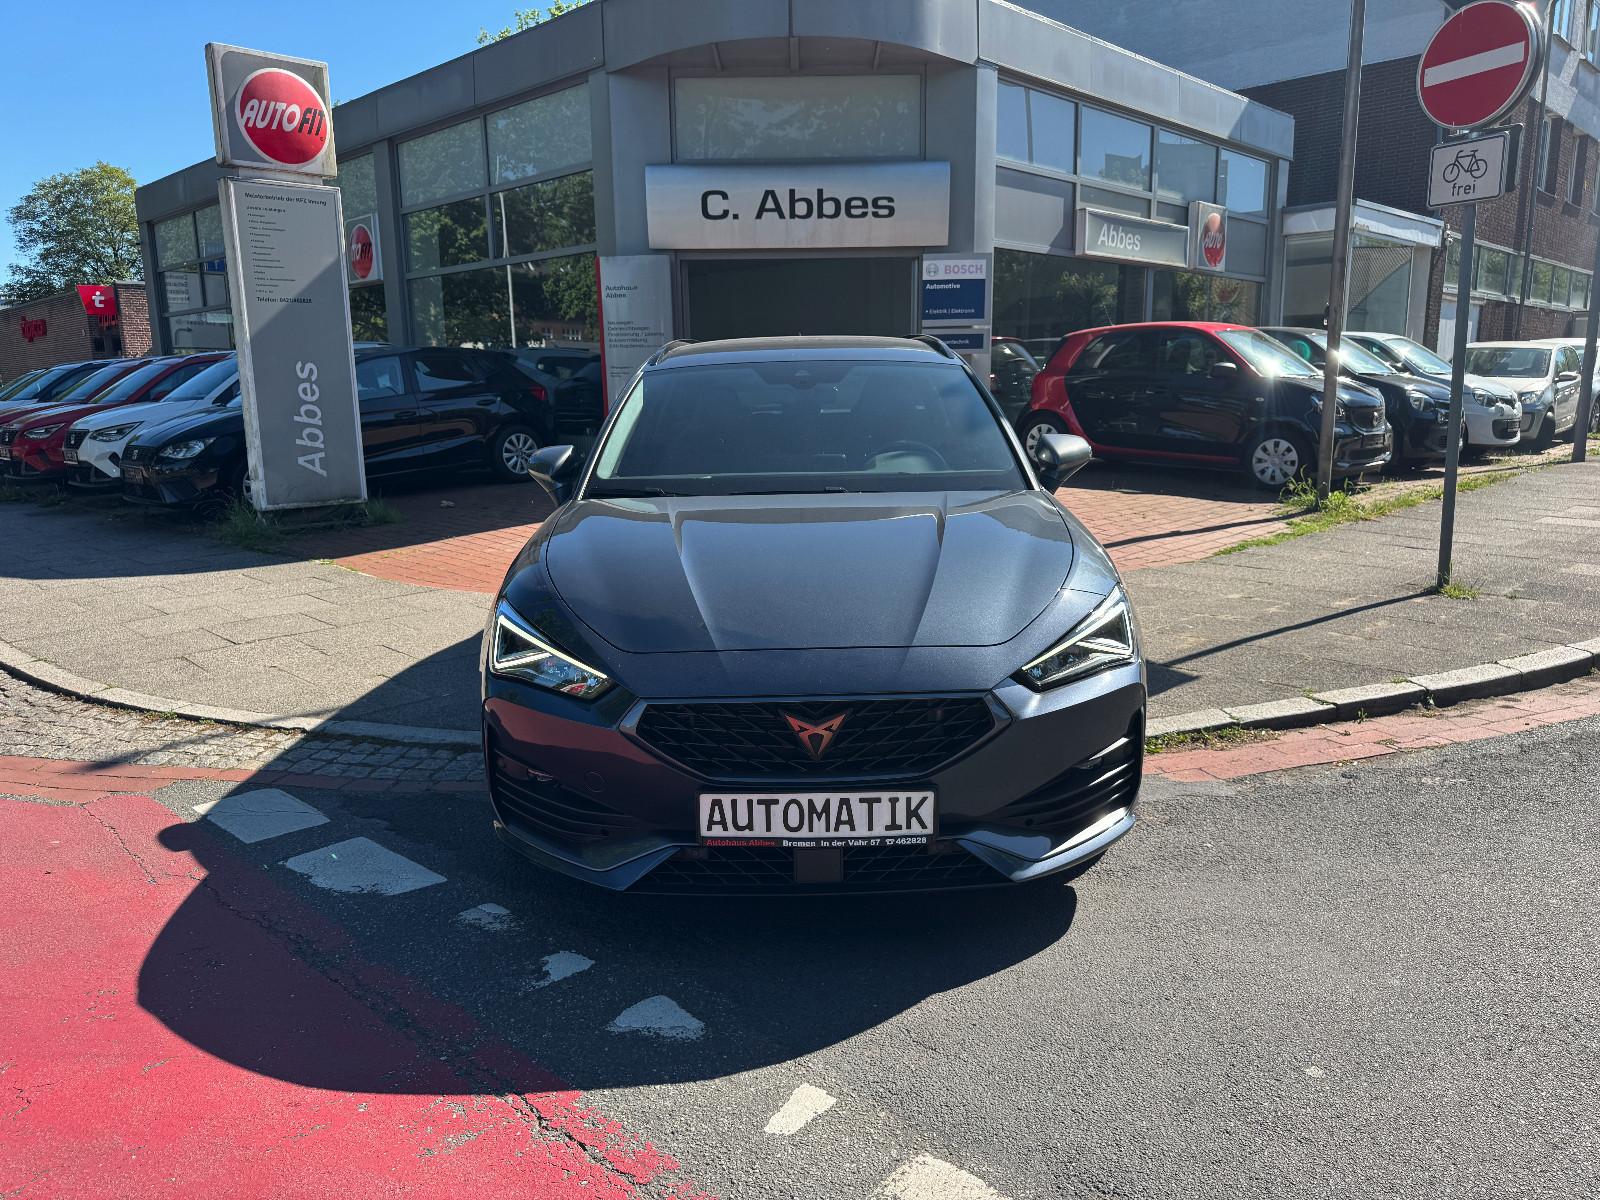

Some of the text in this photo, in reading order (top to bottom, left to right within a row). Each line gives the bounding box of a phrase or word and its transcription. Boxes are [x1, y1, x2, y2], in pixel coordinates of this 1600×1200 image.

[241, 98, 326, 136] AUTOFIT
[1451, 179, 1477, 197] frei
[701, 187, 896, 221] C. Abbes
[1097, 223, 1141, 251] Abbes
[944, 264, 983, 275] BOSCH
[293, 360, 328, 478] Abbes
[706, 796, 929, 833] AUTOMATIK
[706, 839, 746, 847] Autohaus
[782, 839, 816, 847] Bremen
[820, 839, 830, 847] In
[831, 839, 846, 847] der
[848, 838, 868, 846] Vahr
[870, 838, 881, 846] 57
[895, 836, 927, 845] 462828
